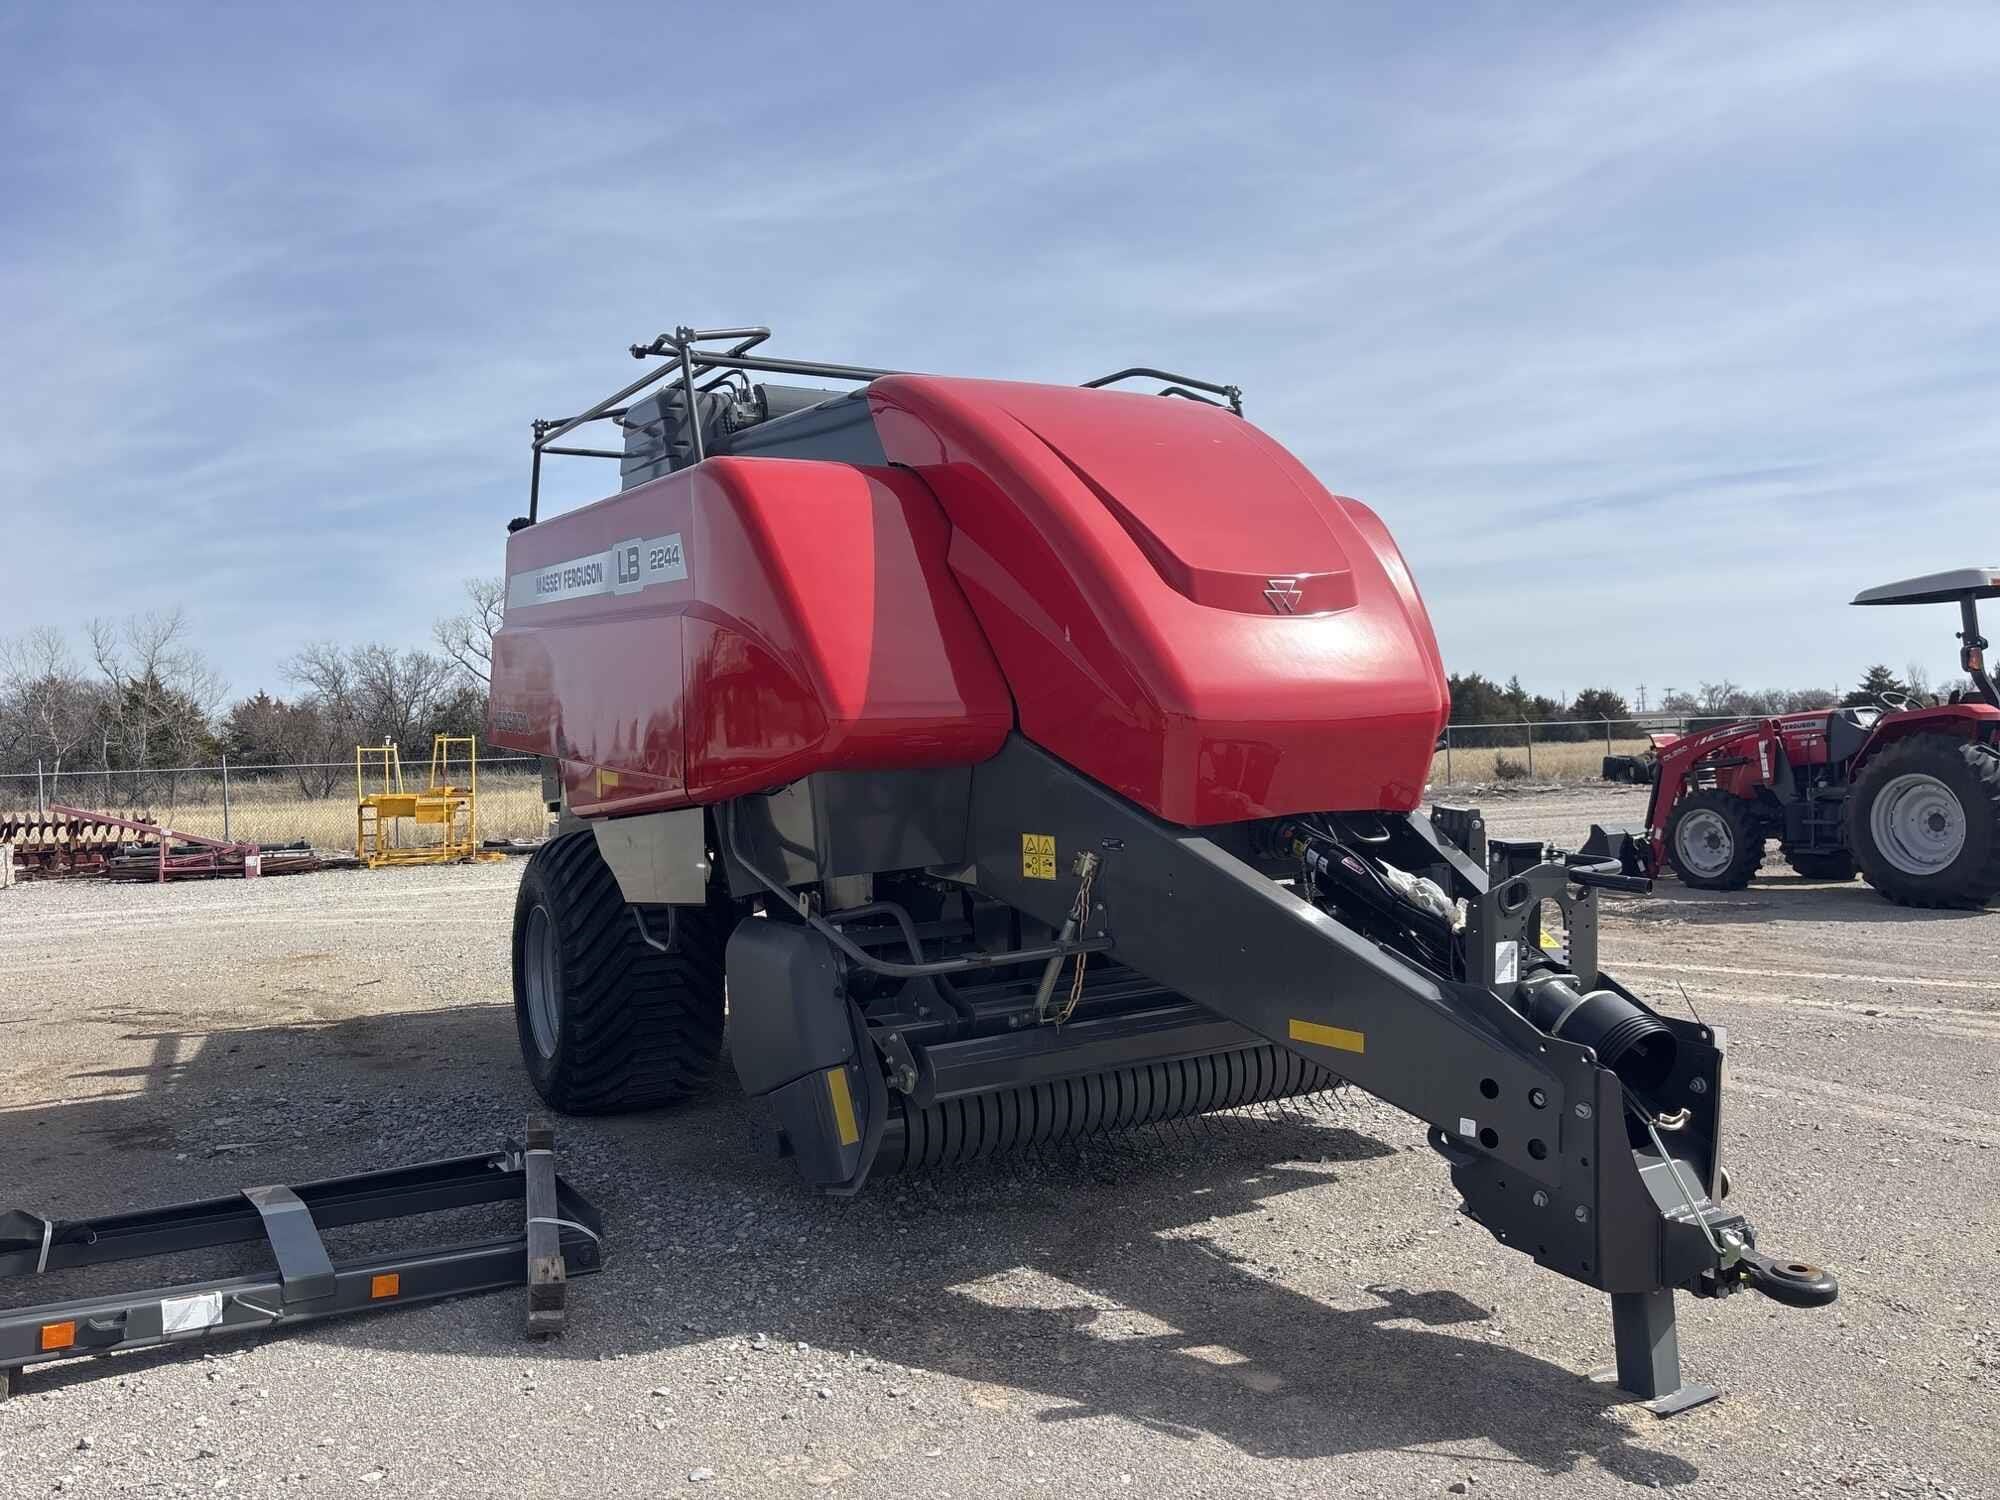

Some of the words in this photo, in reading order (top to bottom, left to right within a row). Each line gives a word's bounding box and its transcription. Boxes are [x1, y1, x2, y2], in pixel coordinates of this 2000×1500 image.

[536, 572, 561, 592] MASSEY
[563, 562, 602, 590] FERGUSON
[617, 546, 640, 584] LB
[650, 545, 680, 570] 2244
